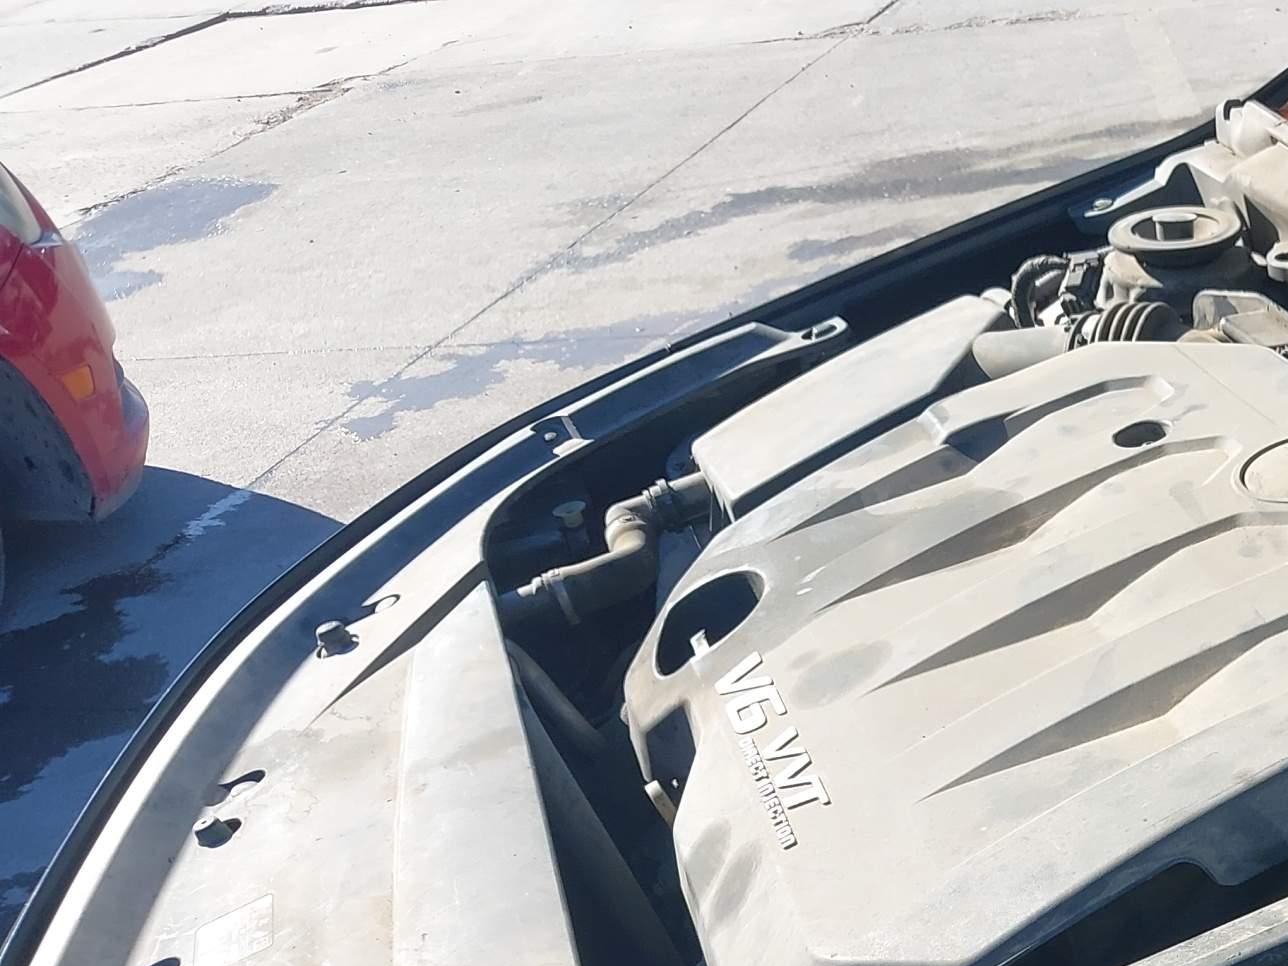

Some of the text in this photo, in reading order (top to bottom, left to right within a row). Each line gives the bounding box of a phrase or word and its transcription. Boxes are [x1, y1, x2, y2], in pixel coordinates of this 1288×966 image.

[714, 650, 832, 810] V6 VVT
[737, 736, 798, 851] DIRECT INJECTION
